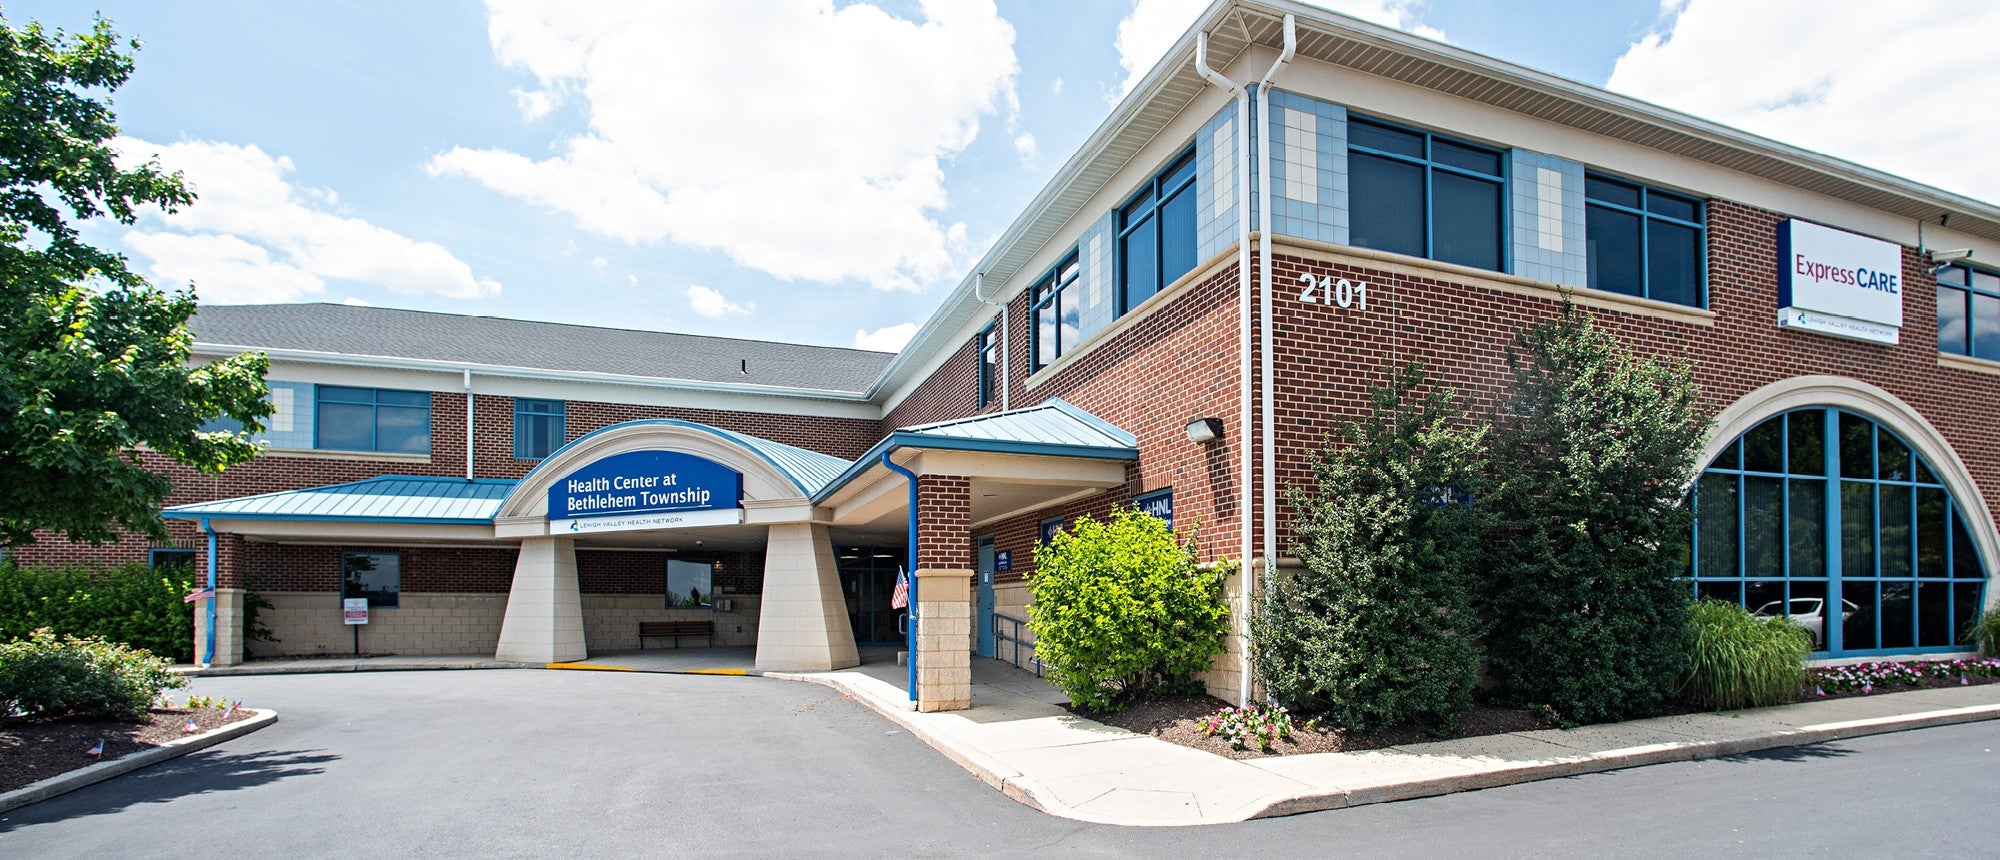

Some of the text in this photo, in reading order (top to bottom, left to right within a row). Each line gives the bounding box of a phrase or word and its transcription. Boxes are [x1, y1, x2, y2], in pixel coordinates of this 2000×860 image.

[1299, 272, 1366, 310] 2101
[1828, 320, 1847, 329] VALLEY
[568, 473, 676, 493] Health Center at
[568, 487, 710, 511] Bethlehem Township
[1152, 499, 1171, 516] HNL
[603, 520, 625, 528] VALLEY
[627, 518, 651, 526] HEALTH
